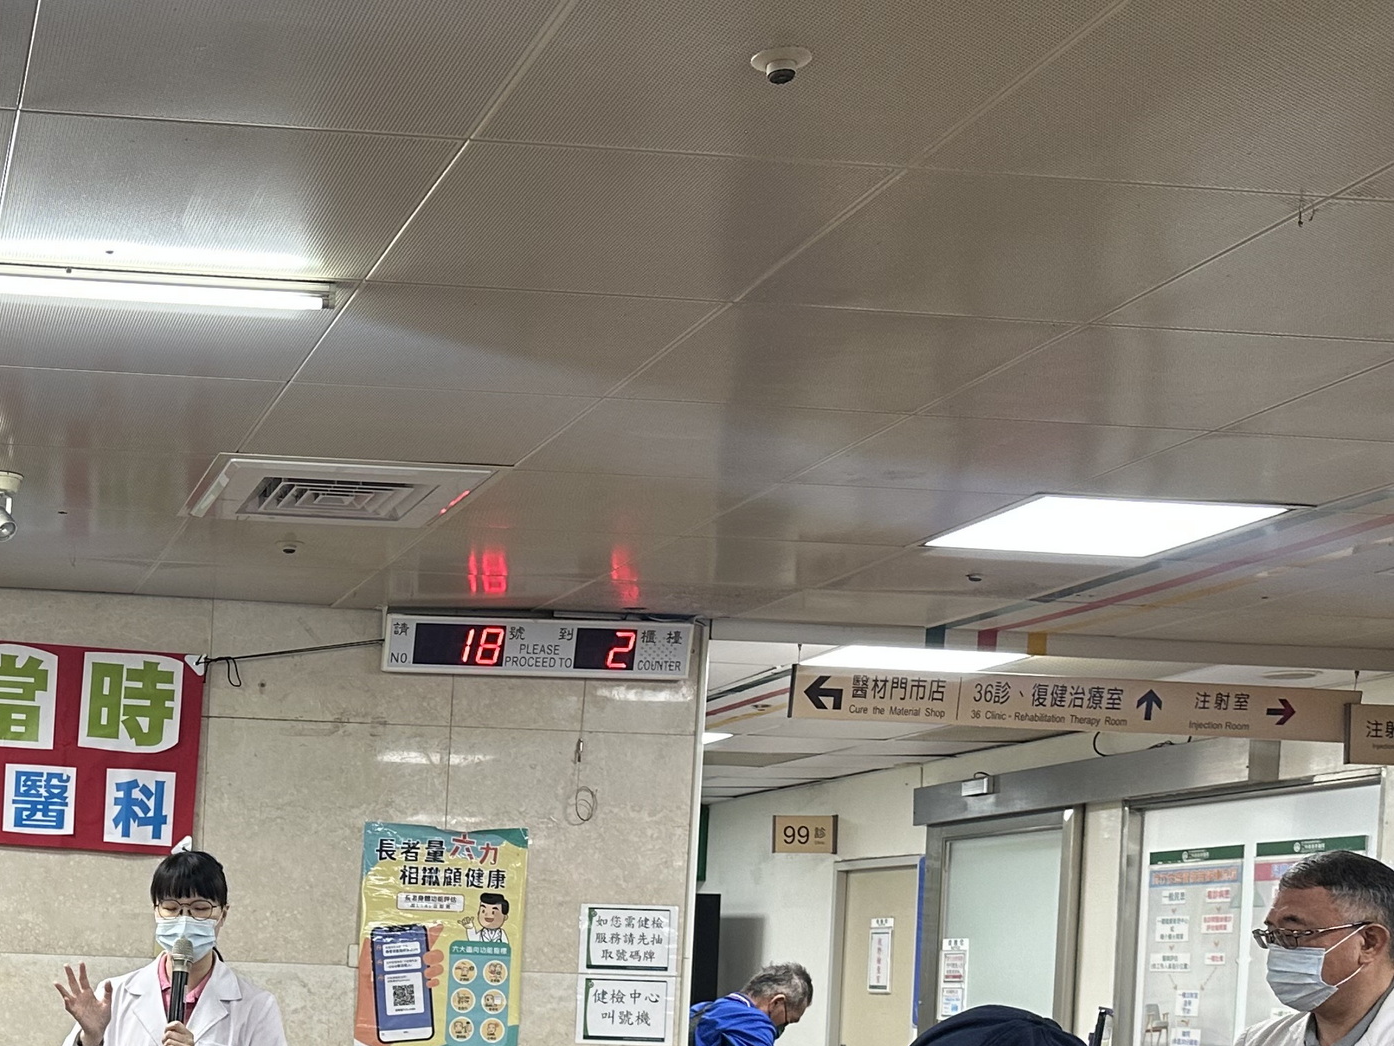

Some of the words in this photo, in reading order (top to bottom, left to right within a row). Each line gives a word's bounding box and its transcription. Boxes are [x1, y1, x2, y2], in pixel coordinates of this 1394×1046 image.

[393, 622, 409, 636] 請
[462, 628, 504, 664] 18
[509, 626, 525, 640] 號
[558, 628, 574, 641] 到
[606, 632, 636, 668] 2
[519, 644, 560, 655] PLEASE
[505, 656, 555, 668] PROCEED
[558, 657, 572, 668] TO
[637, 660, 681, 671] COUNTER
[852, 675, 946, 702] 醫材門市店
[1194, 692, 1250, 711] 注射室
[849, 704, 868, 715] Cure
[873, 705, 885, 715] the
[889, 706, 920, 717] Material
[924, 707, 945, 719] Shop
[970, 710, 981, 720] 36
[985, 710, 1006, 721] Clinic
[1014, 712, 1065, 724] Rehabilitation
[1070, 714, 1101, 726] Therapy
[1105, 717, 1128, 727] Room
[1189, 720, 1222, 731] Injection
[1224, 721, 1250, 731] Room
[376, 834, 499, 866] 長者量六力
[596, 916, 664, 930] 如您需健檢
[595, 932, 663, 946] 服務請先抽
[601, 949, 656, 963] 取號碼牌
[592, 989, 661, 1005] 健檢中心
[601, 1010, 651, 1026] 叫號機
